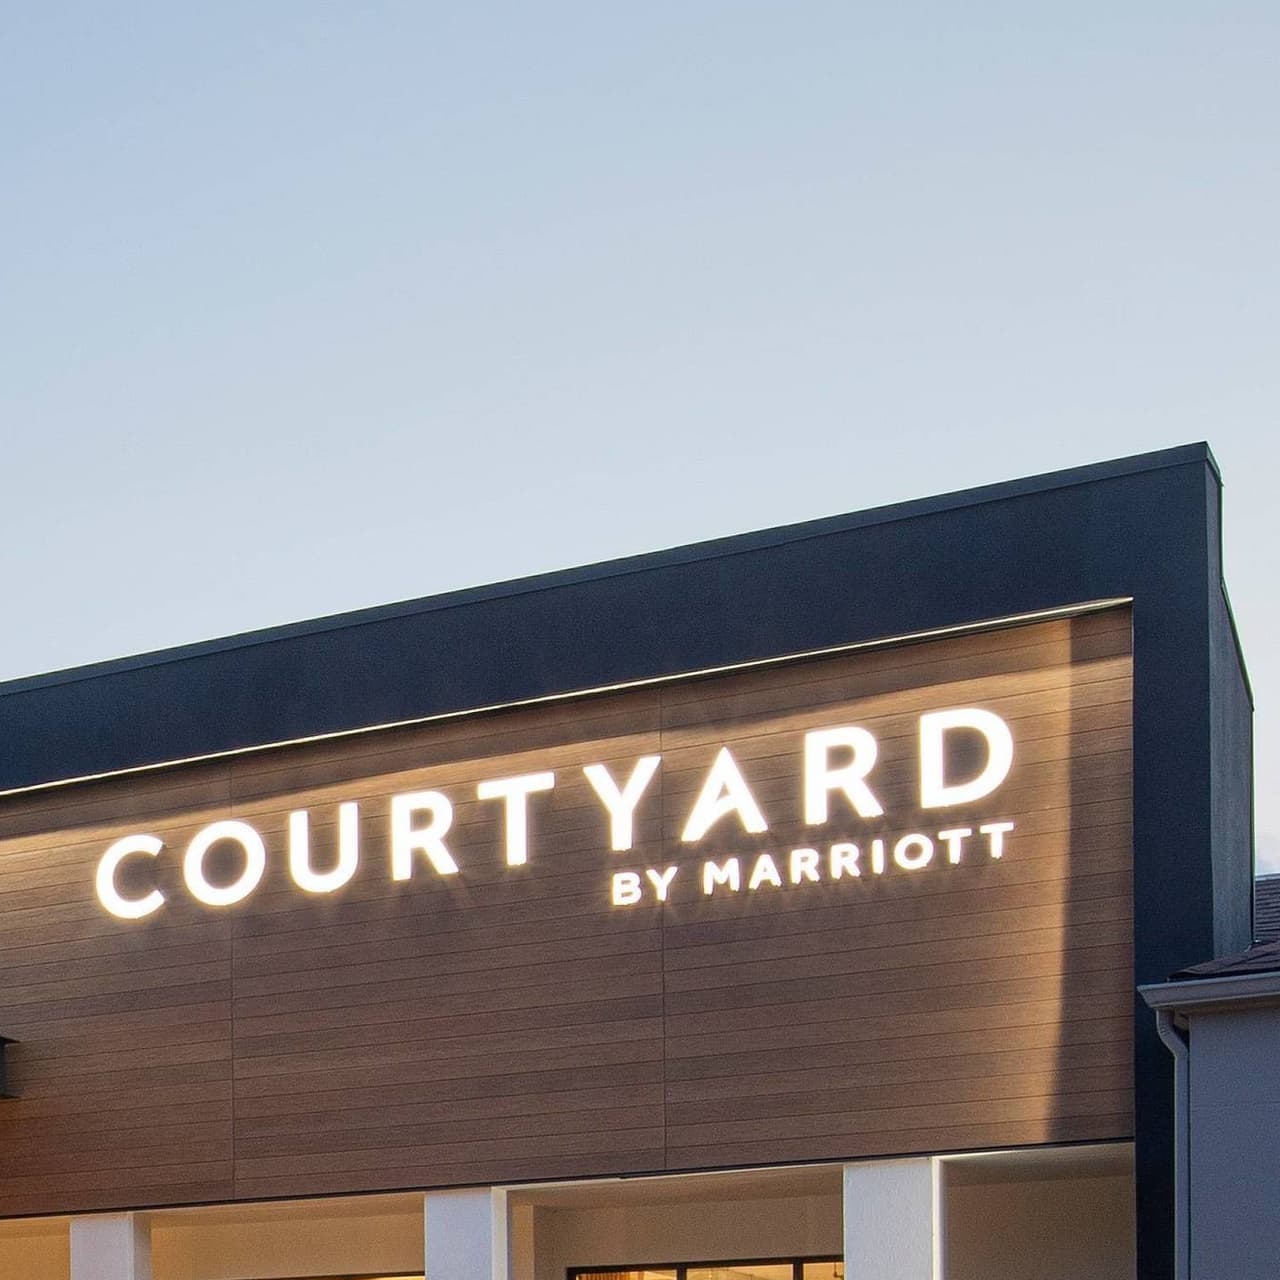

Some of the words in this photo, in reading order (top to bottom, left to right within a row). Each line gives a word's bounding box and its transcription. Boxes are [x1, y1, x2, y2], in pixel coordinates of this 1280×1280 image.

[94, 706, 1015, 920] COURTYARD
[612, 866, 678, 907] BY
[703, 822, 1014, 896] MARRIOTT
